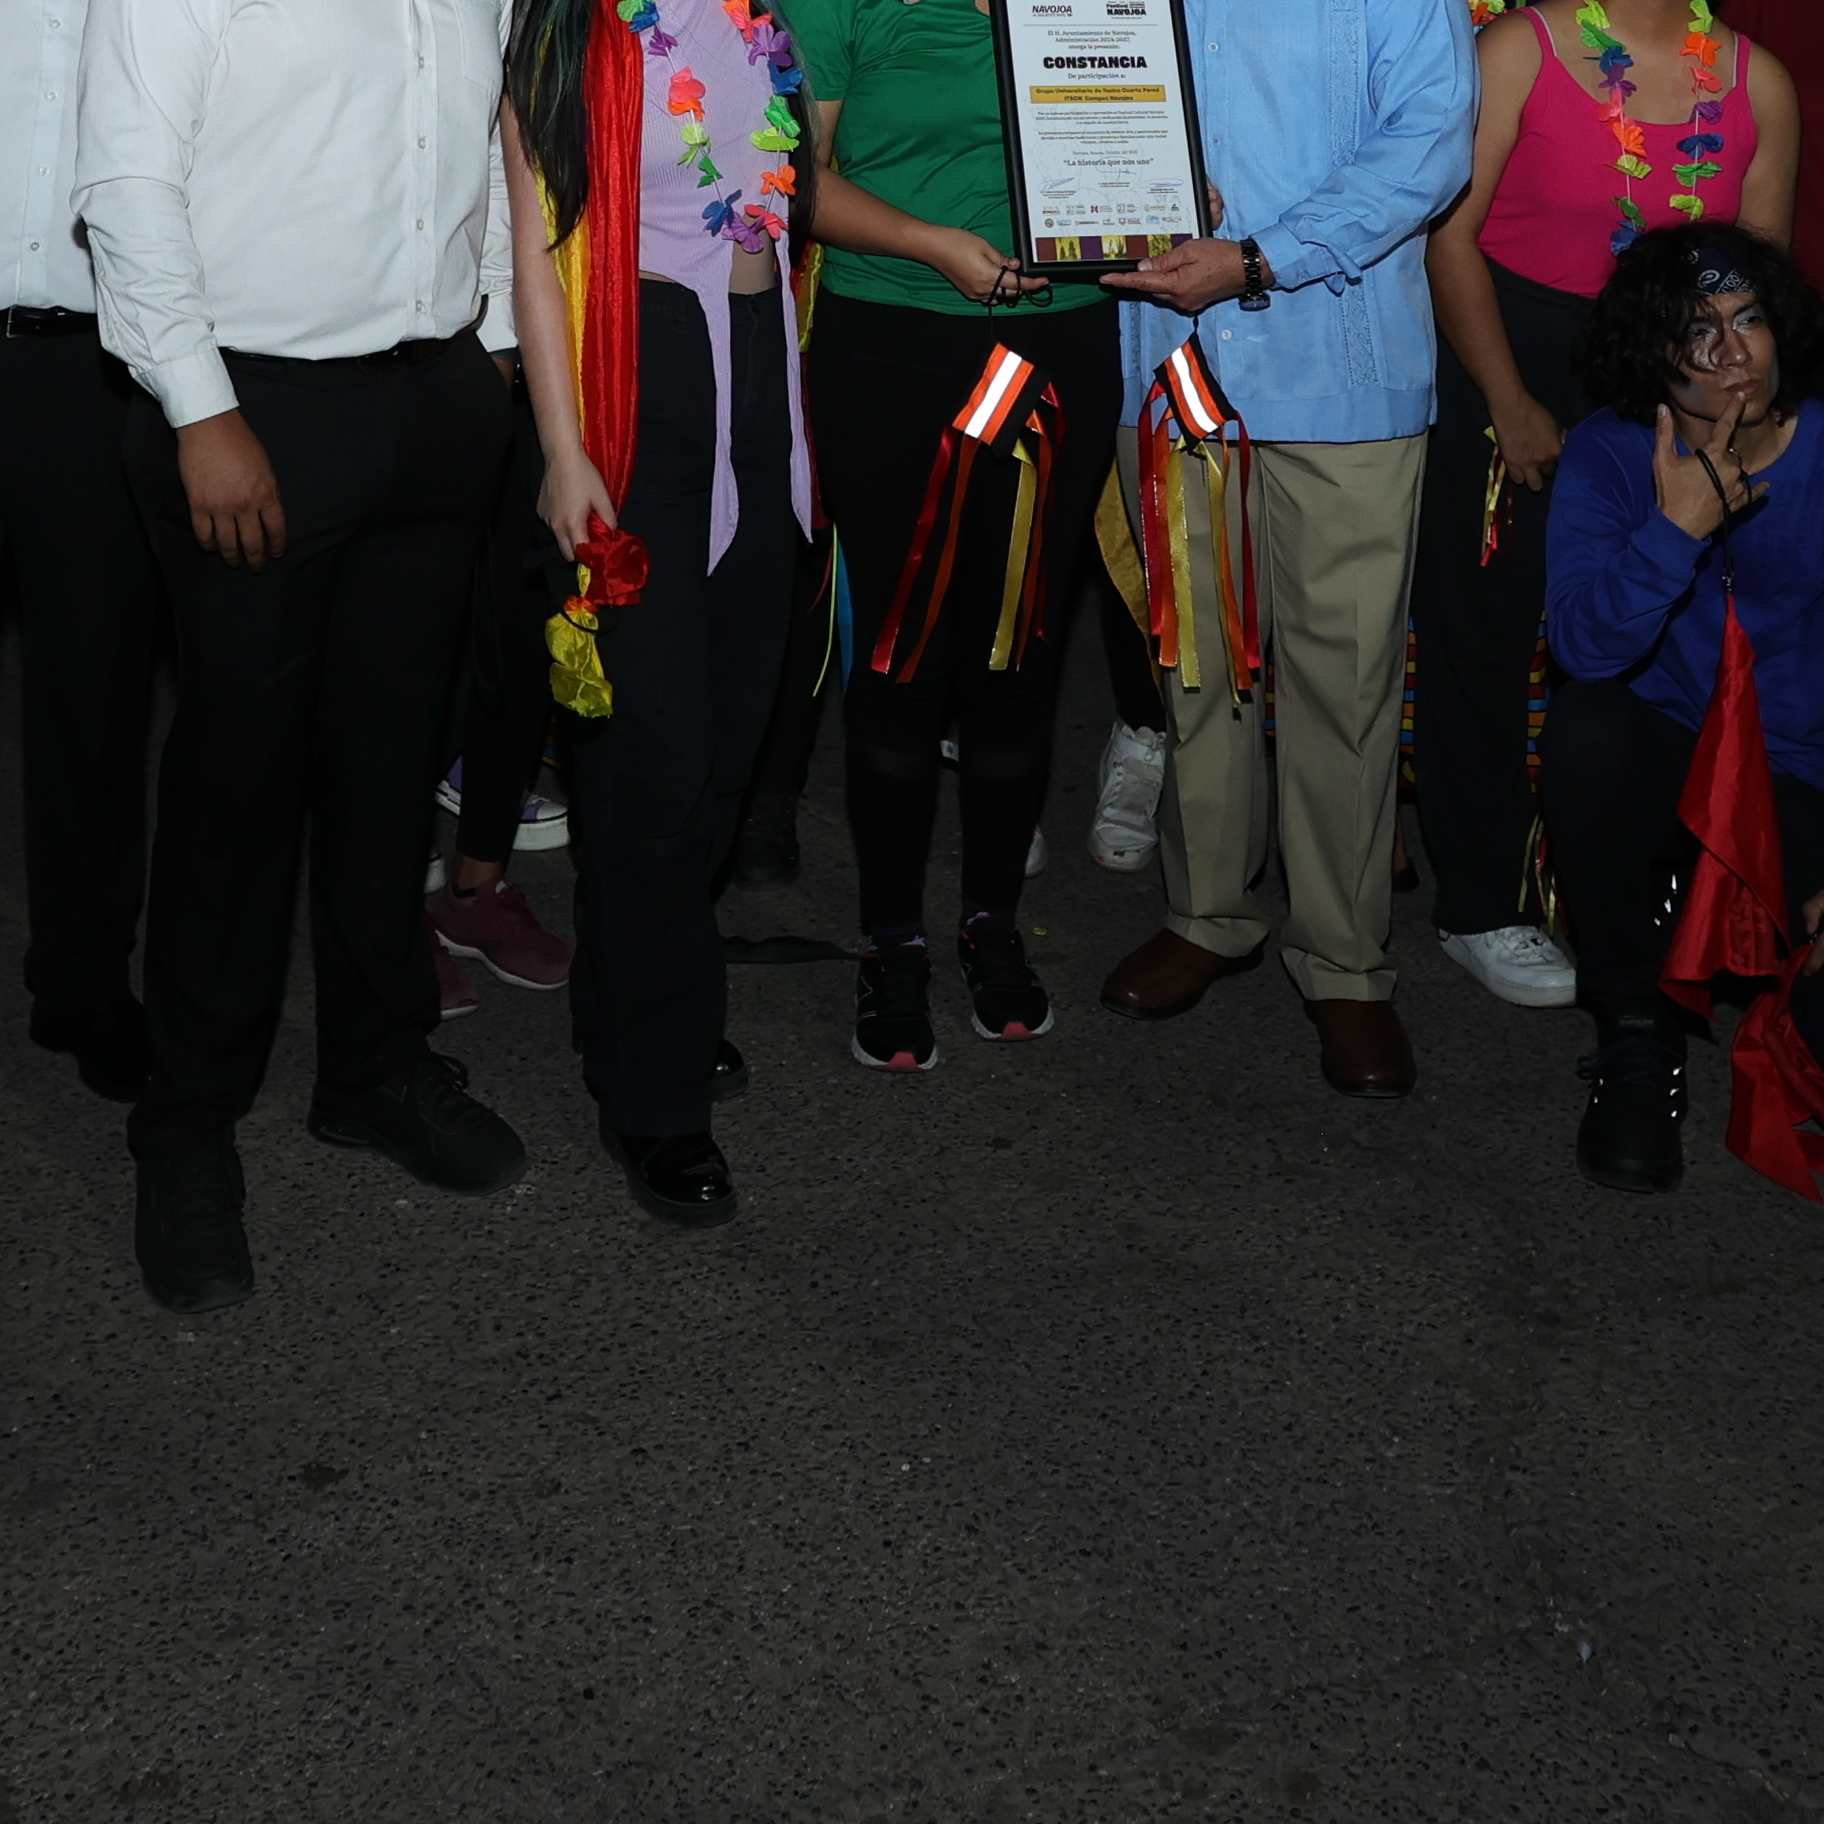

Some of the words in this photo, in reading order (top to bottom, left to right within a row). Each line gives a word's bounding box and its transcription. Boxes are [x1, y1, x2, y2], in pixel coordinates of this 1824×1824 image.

[1032, 5, 1072, 13] NAVOJOA
[1043, 56, 1148, 69] CONSTANCIA
[1078, 72, 1119, 80] participación
[1107, 159, 1121, 167] que
